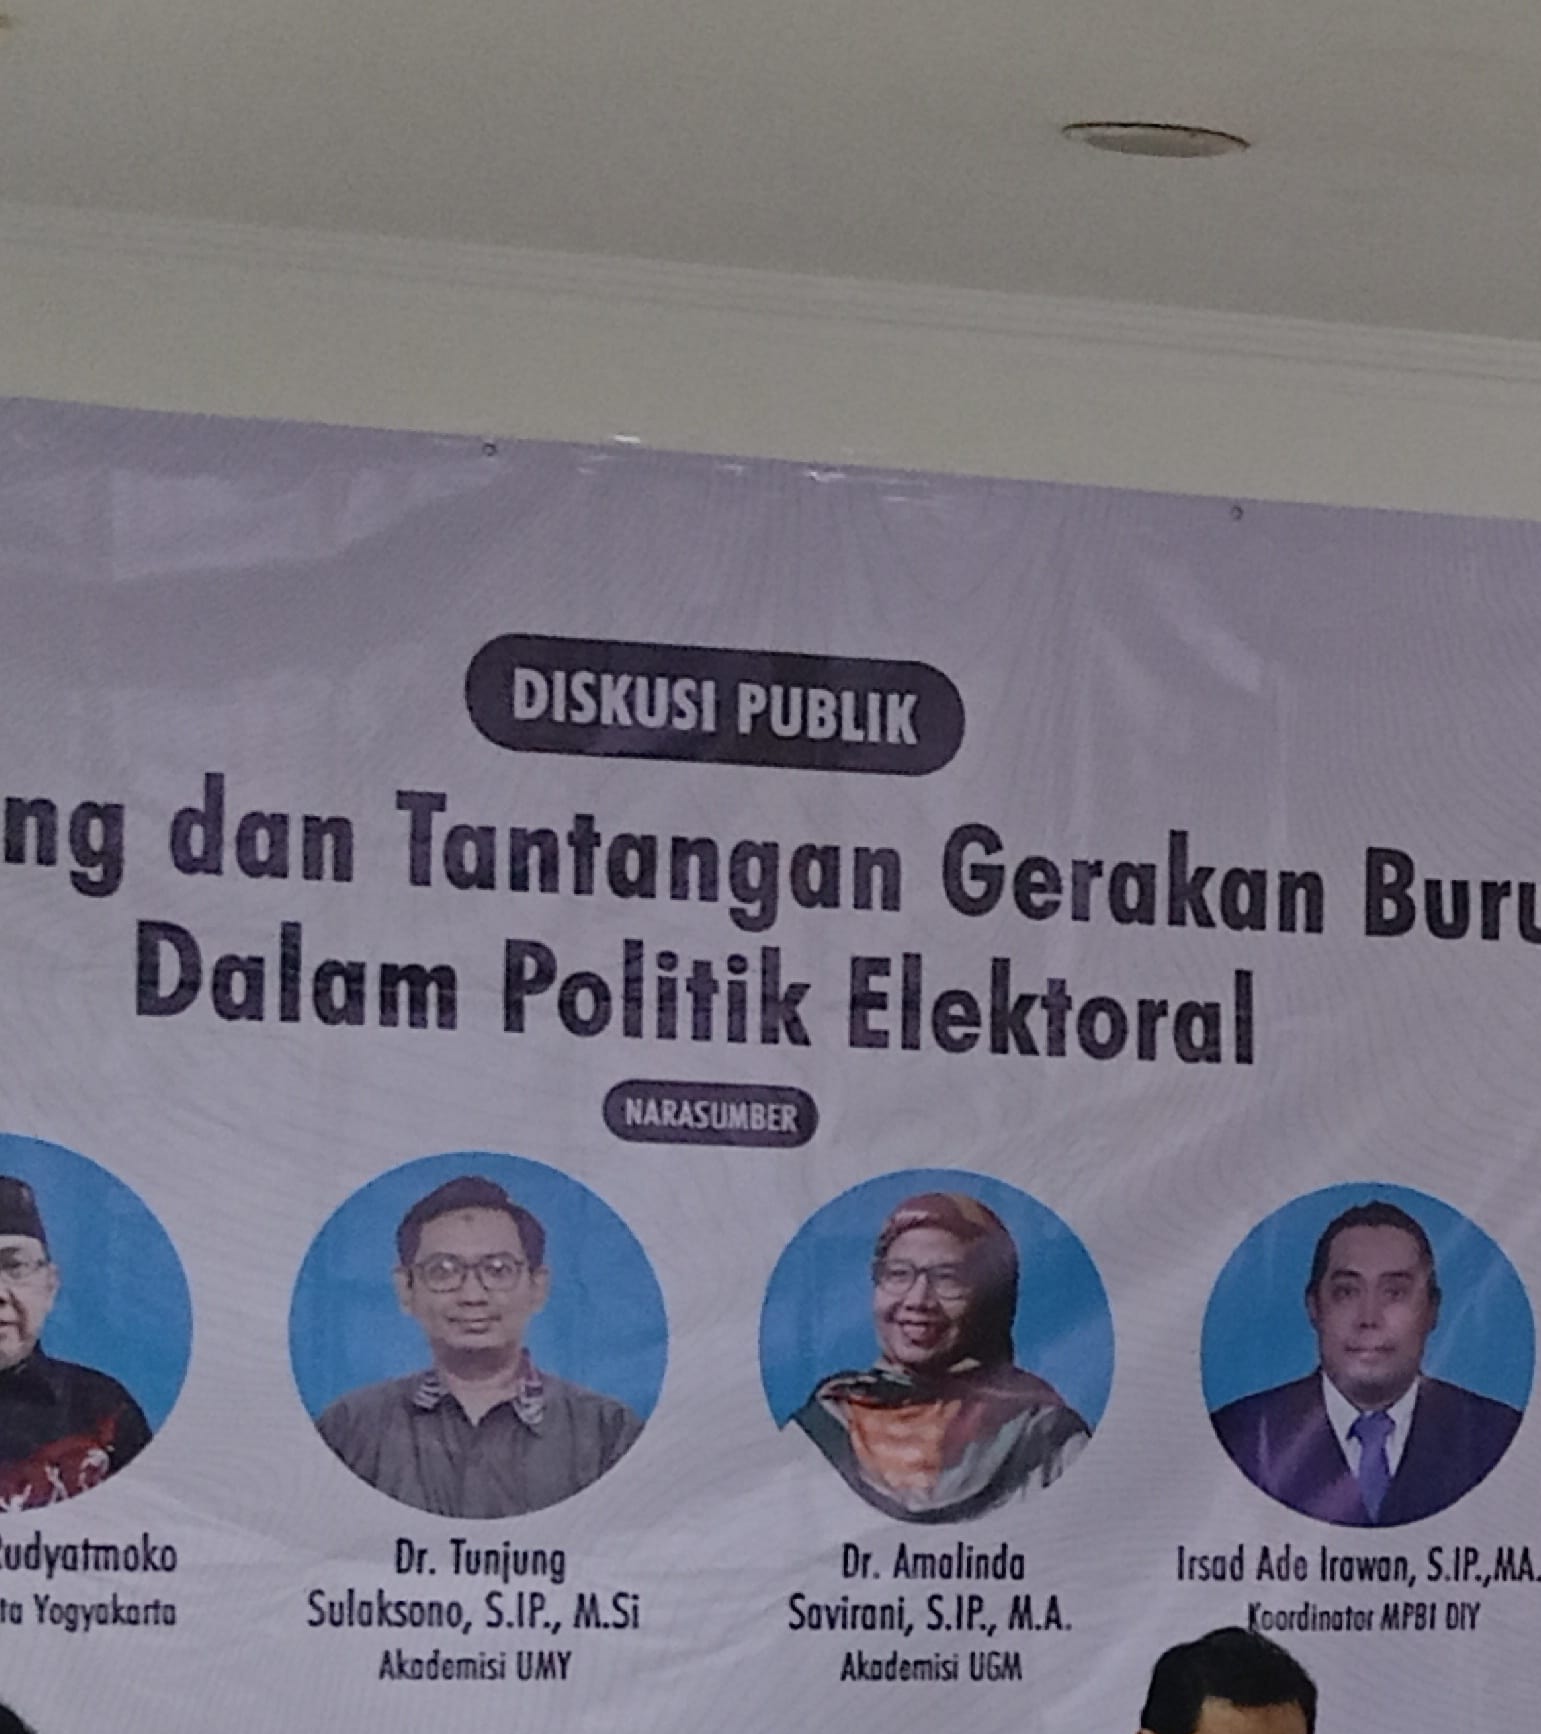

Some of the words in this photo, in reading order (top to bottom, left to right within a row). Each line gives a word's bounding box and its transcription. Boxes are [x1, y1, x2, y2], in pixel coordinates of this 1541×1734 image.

[513, 667, 716, 732] DISKUSI
[738, 683, 917, 745] PUBLIK
[171, 773, 354, 882] dan
[396, 791, 902, 933] Tantangan
[943, 824, 1325, 933] Gerakan
[135, 920, 457, 1029] Dalam
[504, 938, 812, 1047] Politik
[848, 952, 1255, 1064] Elektoral
[625, 1097, 798, 1134] NARASUMBER
[0, 1530, 178, 1580] udyatmoko
[395, 1539, 436, 1574] Dr.
[451, 1539, 565, 1583] Tunjung
[842, 1543, 879, 1581] Dr.
[893, 1543, 1025, 1581] Amalinda
[1177, 1545, 1245, 1583] Irsad
[1255, 1545, 1309, 1583] Ade
[1320, 1547, 1417, 1588] Irawan,
[33, 1592, 176, 1633] Yogyakarta
[307, 1589, 472, 1633] Sulaksono,
[573, 1592, 639, 1629] M.Si
[788, 1593, 916, 1637] Savirani,
[1008, 1597, 1073, 1631] M.A.
[1247, 1602, 1374, 1634] Koordinator
[1445, 1603, 1480, 1630] DIY
[379, 1648, 505, 1680] Akademisi
[517, 1651, 571, 1680] UMY
[841, 1652, 959, 1682] Akademisi
[969, 1653, 1023, 1682] UGM
